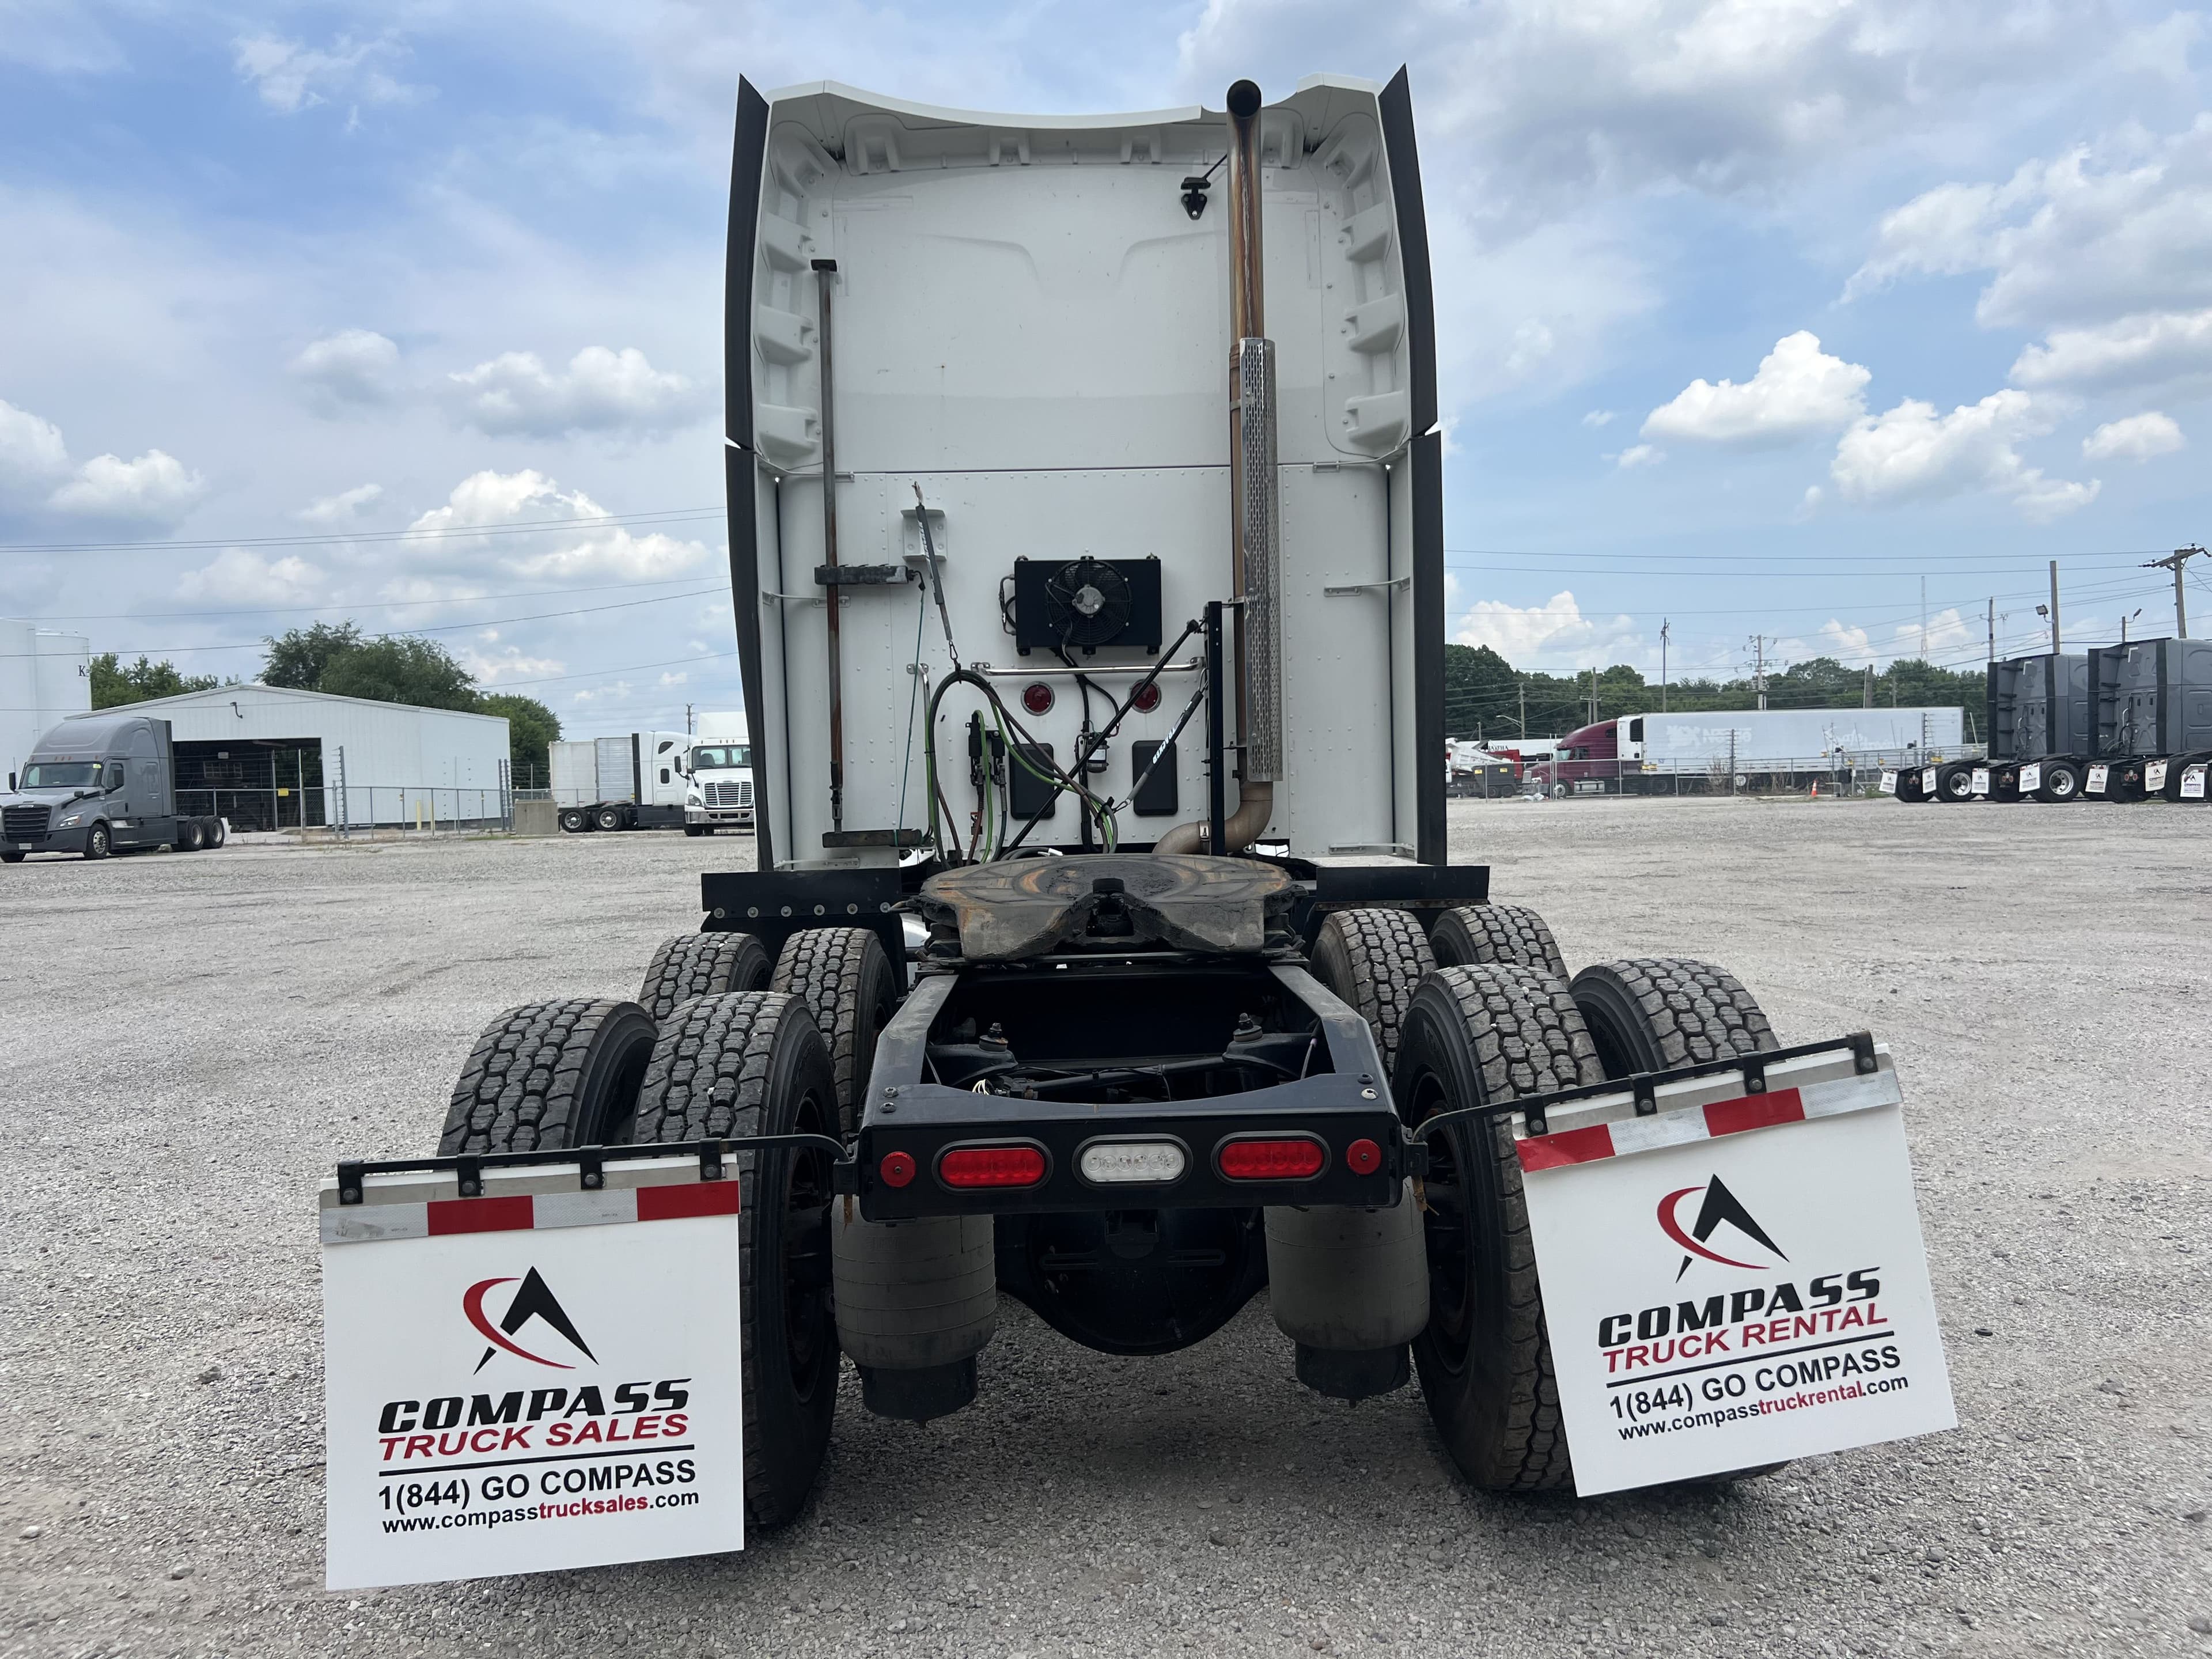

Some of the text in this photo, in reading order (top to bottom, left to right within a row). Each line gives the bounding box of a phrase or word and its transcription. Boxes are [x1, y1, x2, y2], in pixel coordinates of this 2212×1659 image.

[1599, 1267, 1880, 1347] COMPASS
[1603, 1302, 1888, 1373] TRUCK RENTAL
[378, 1378, 692, 1433] COMPASS
[1610, 1346, 1900, 1422] 1(844) GO COMPASS
[1618, 1376, 1908, 1440] www.compasstruckrental.com
[379, 1414, 688, 1461] TRUCK SALES
[379, 1459, 695, 1515] 1(844) GO COMPASS
[382, 1492, 699, 1533] www.compasstrucksales.com
